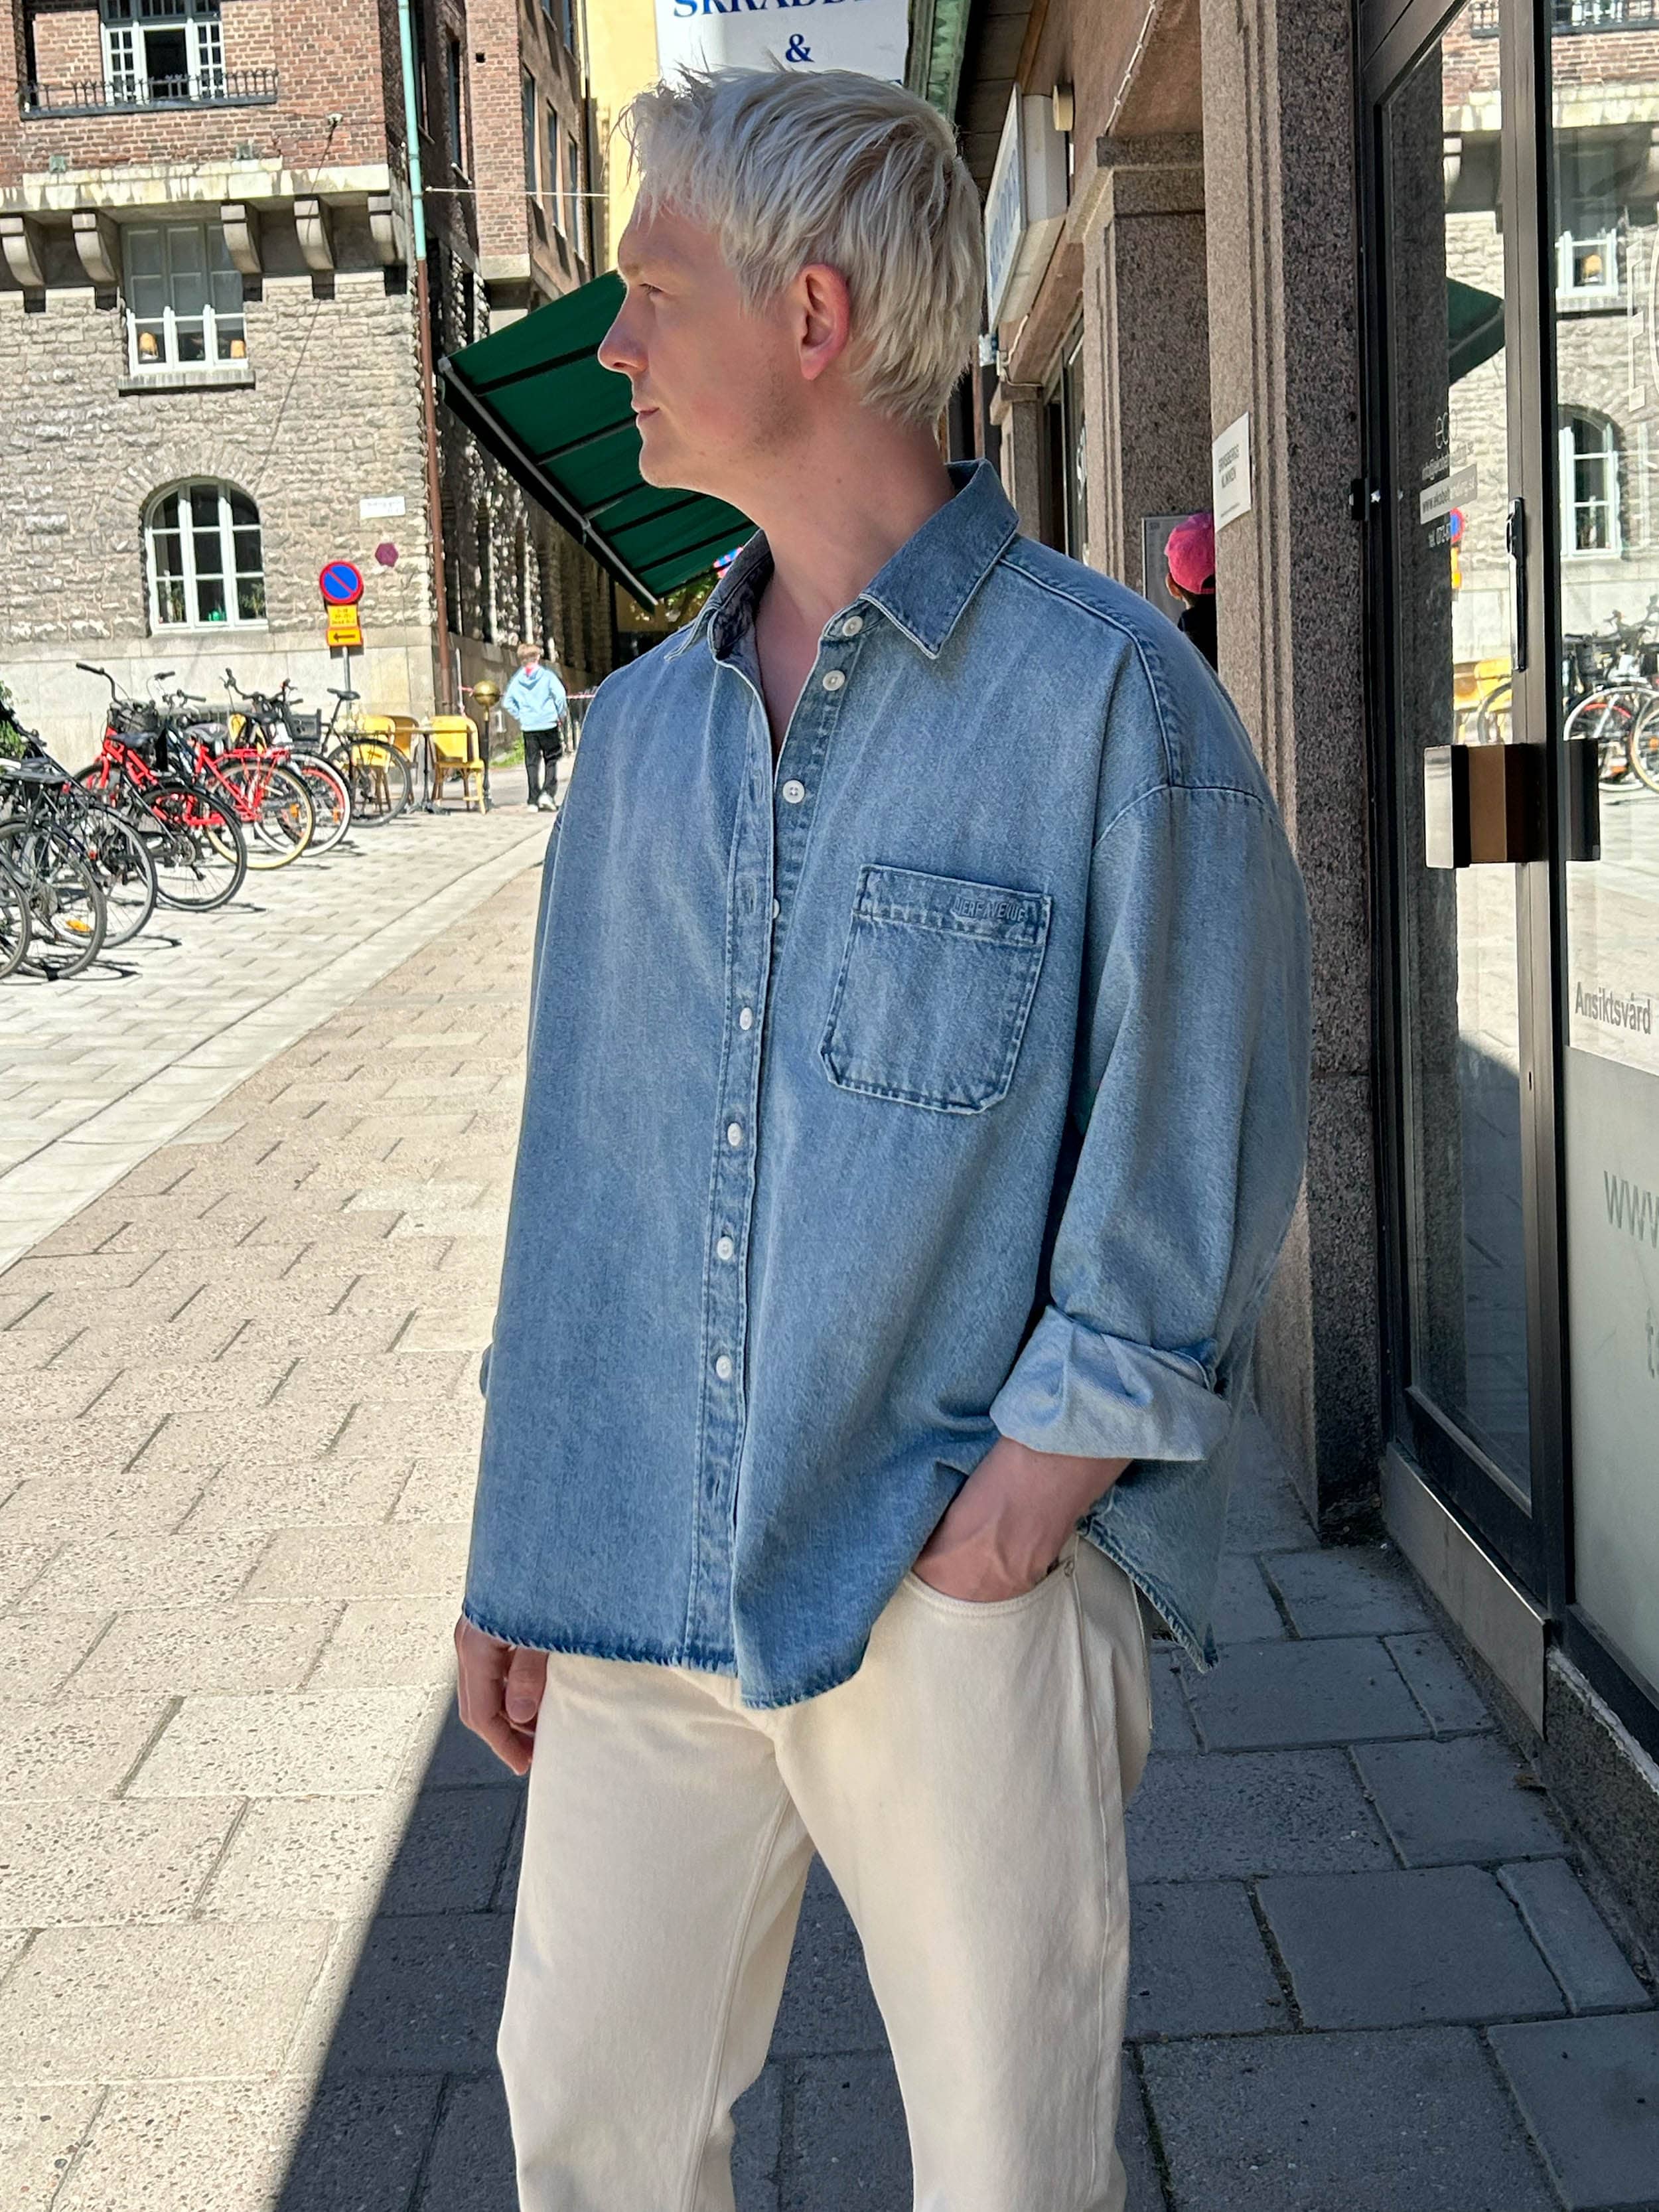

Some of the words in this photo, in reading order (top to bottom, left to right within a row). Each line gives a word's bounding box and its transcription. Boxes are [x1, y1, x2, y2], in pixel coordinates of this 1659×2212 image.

[785, 33, 814, 63] &
[982, 899, 1026, 923] AVENUE
[1575, 981, 1651, 1035] Ansiktsvård
